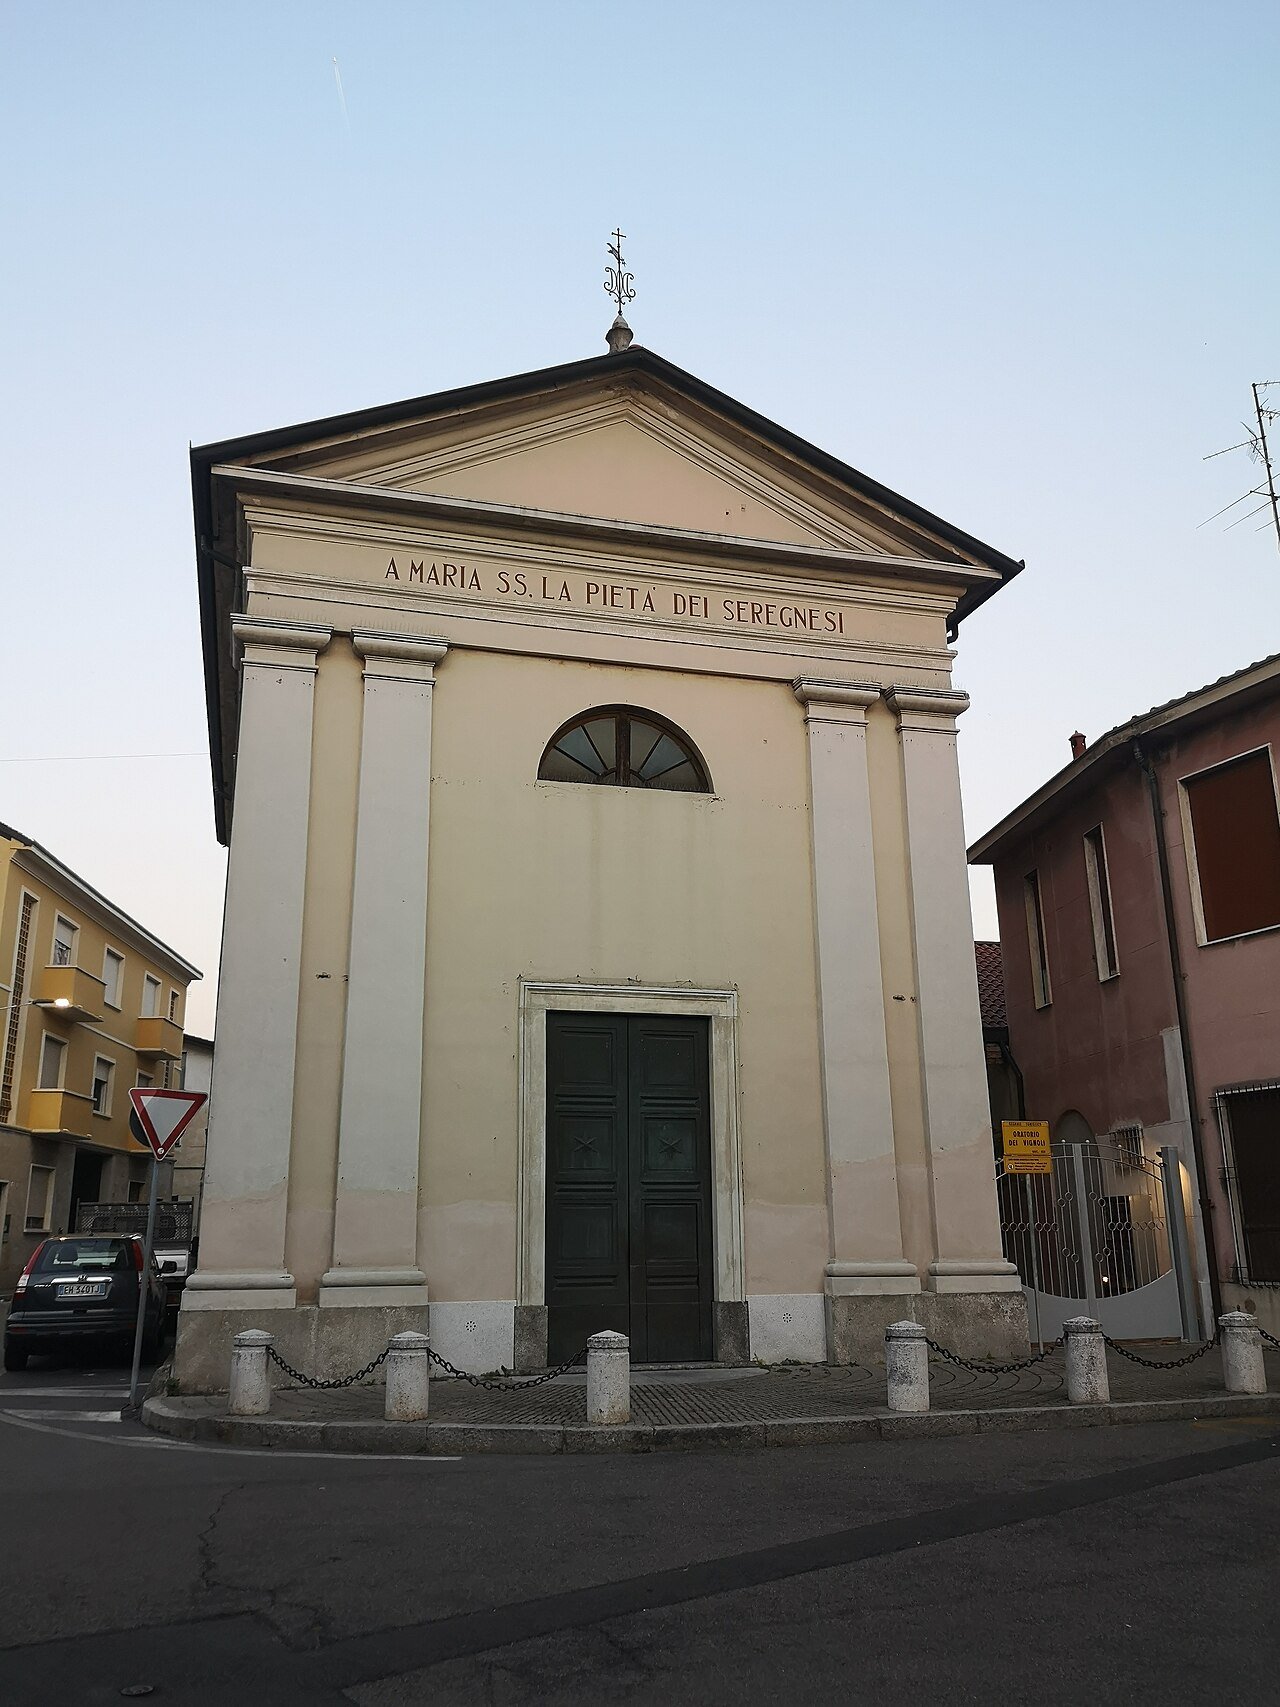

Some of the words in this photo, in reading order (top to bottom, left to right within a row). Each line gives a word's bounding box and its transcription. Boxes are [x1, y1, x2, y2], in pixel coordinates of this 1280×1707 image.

[385, 557, 400, 580] A
[409, 559, 482, 591] MARIA
[496, 571, 533, 598] SS.
[541, 576, 572, 602] LA
[673, 593, 709, 618] DEI
[723, 600, 844, 633] SEREGNESI
